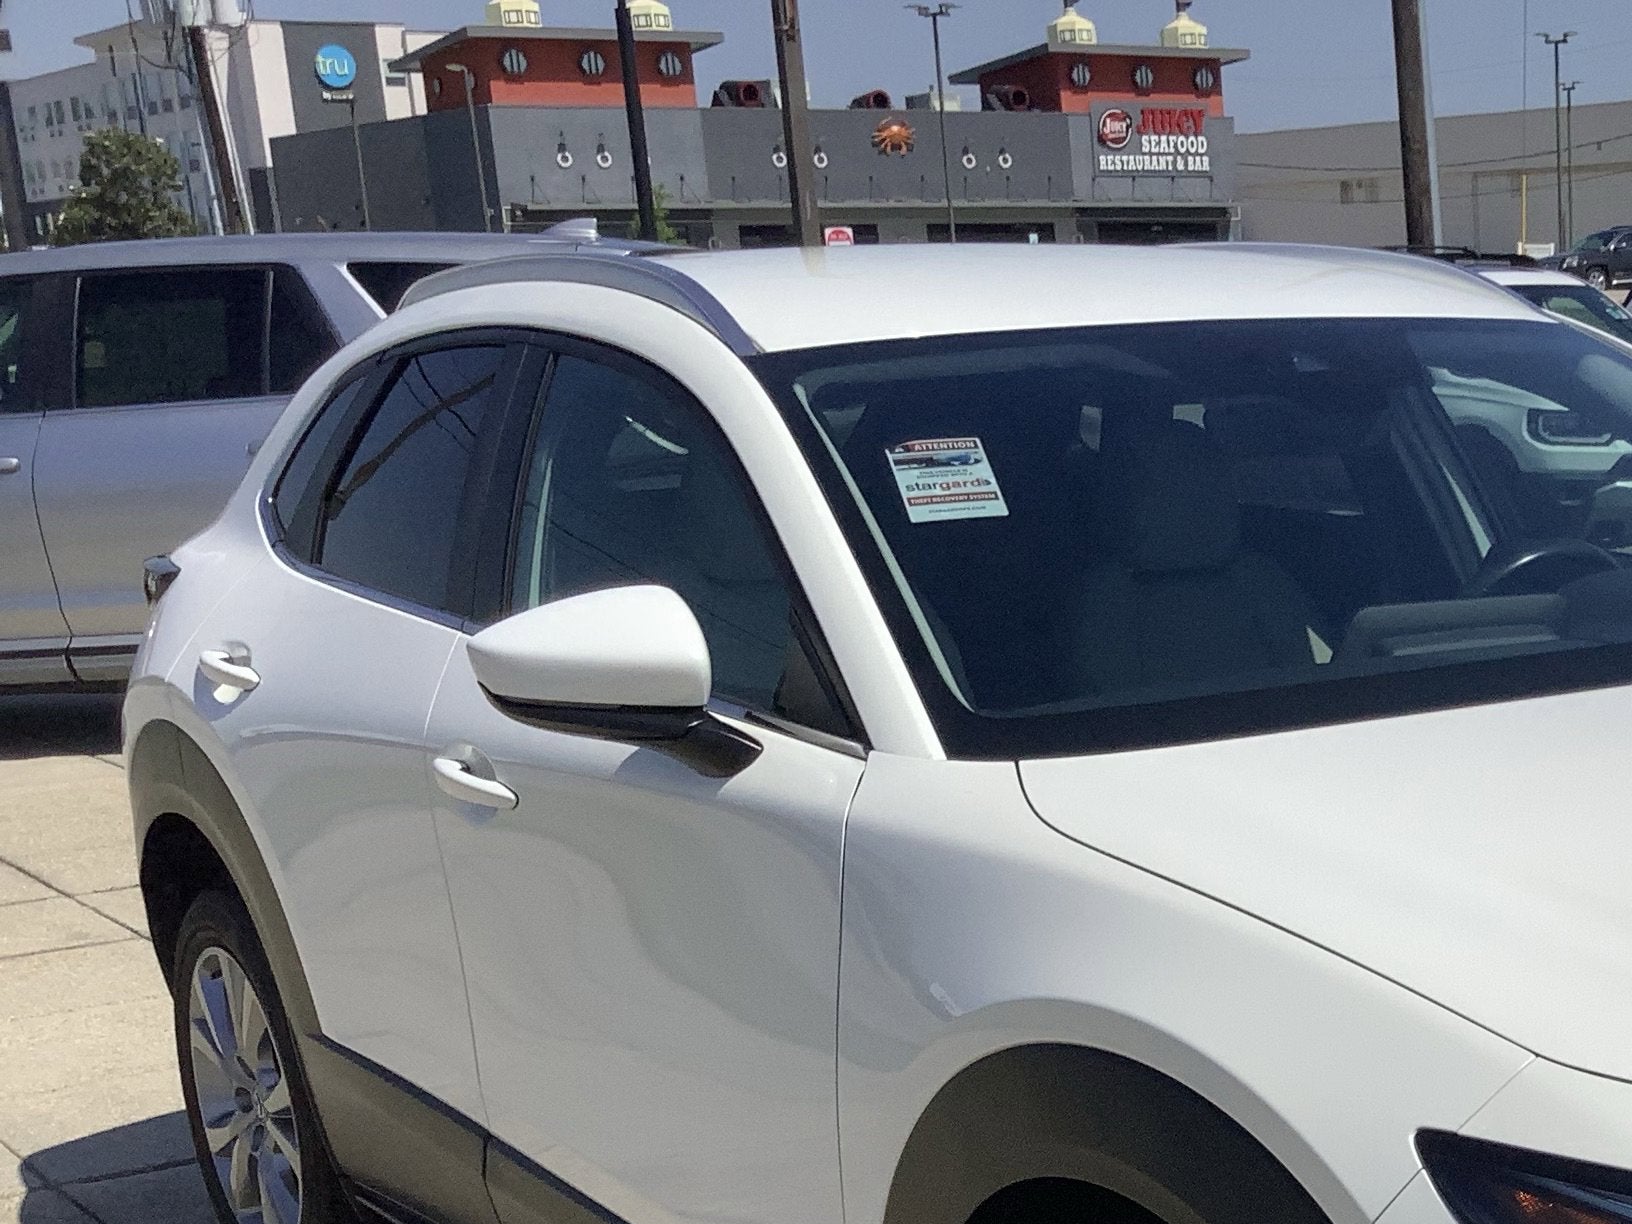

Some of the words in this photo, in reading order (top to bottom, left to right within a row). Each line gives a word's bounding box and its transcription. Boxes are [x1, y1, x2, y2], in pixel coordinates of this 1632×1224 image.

[315, 54, 349, 76] tru
[1136, 108, 1204, 135] JUICY
[1141, 135, 1208, 153] SEAFOOD
[1099, 154, 1174, 171] RESTAURANT
[1176, 155, 1185, 171] &
[1187, 155, 1210, 171] BAR
[914, 441, 975, 451] ATTENTION
[910, 497, 932, 505] THEFT
[932, 494, 968, 503] RECOVERY
[969, 493, 996, 501] SYSTEM
